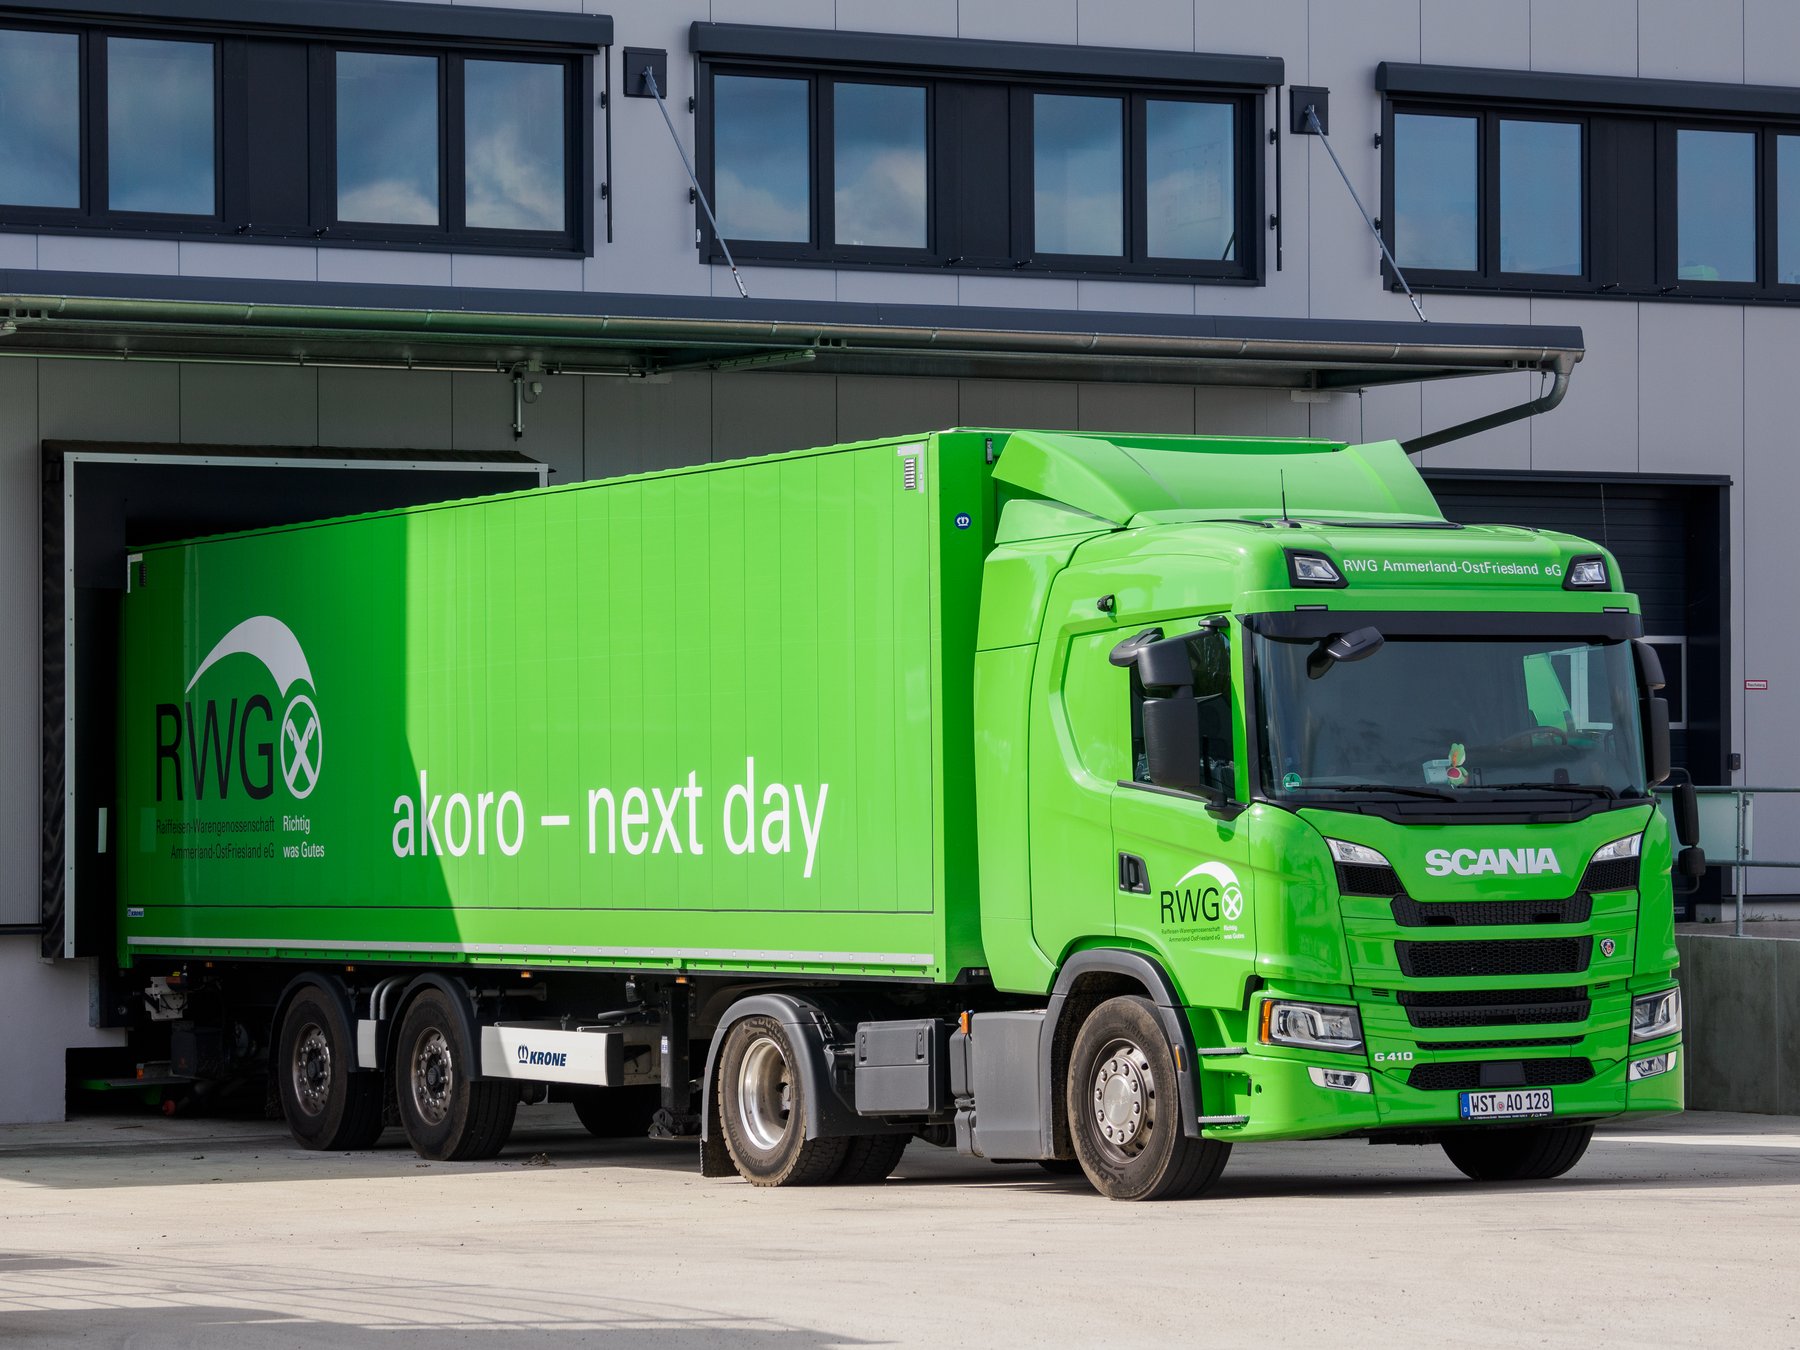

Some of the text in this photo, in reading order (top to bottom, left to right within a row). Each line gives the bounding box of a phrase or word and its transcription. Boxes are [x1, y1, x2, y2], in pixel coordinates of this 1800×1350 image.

[1343, 559, 1562, 577] RWG Ammerland-OstFriesland eG
[156, 694, 274, 802] RWG
[156, 816, 275, 836] Raiffeisen-Warengenossenschaft
[283, 815, 311, 834] Richtig
[393, 769, 525, 858] akoro
[588, 769, 704, 856] next
[723, 756, 829, 879] day
[171, 842, 275, 860] Ammerland-OstFriesland eG
[283, 841, 325, 858] was Gutes
[1425, 847, 1561, 876] SCANIA
[1160, 887, 1220, 924] RWG
[529, 1051, 567, 1067] KRONE
[1374, 1051, 1413, 1062] G 410
[1471, 1094, 1496, 1112] WST
[1525, 1092, 1550, 1110] 128
